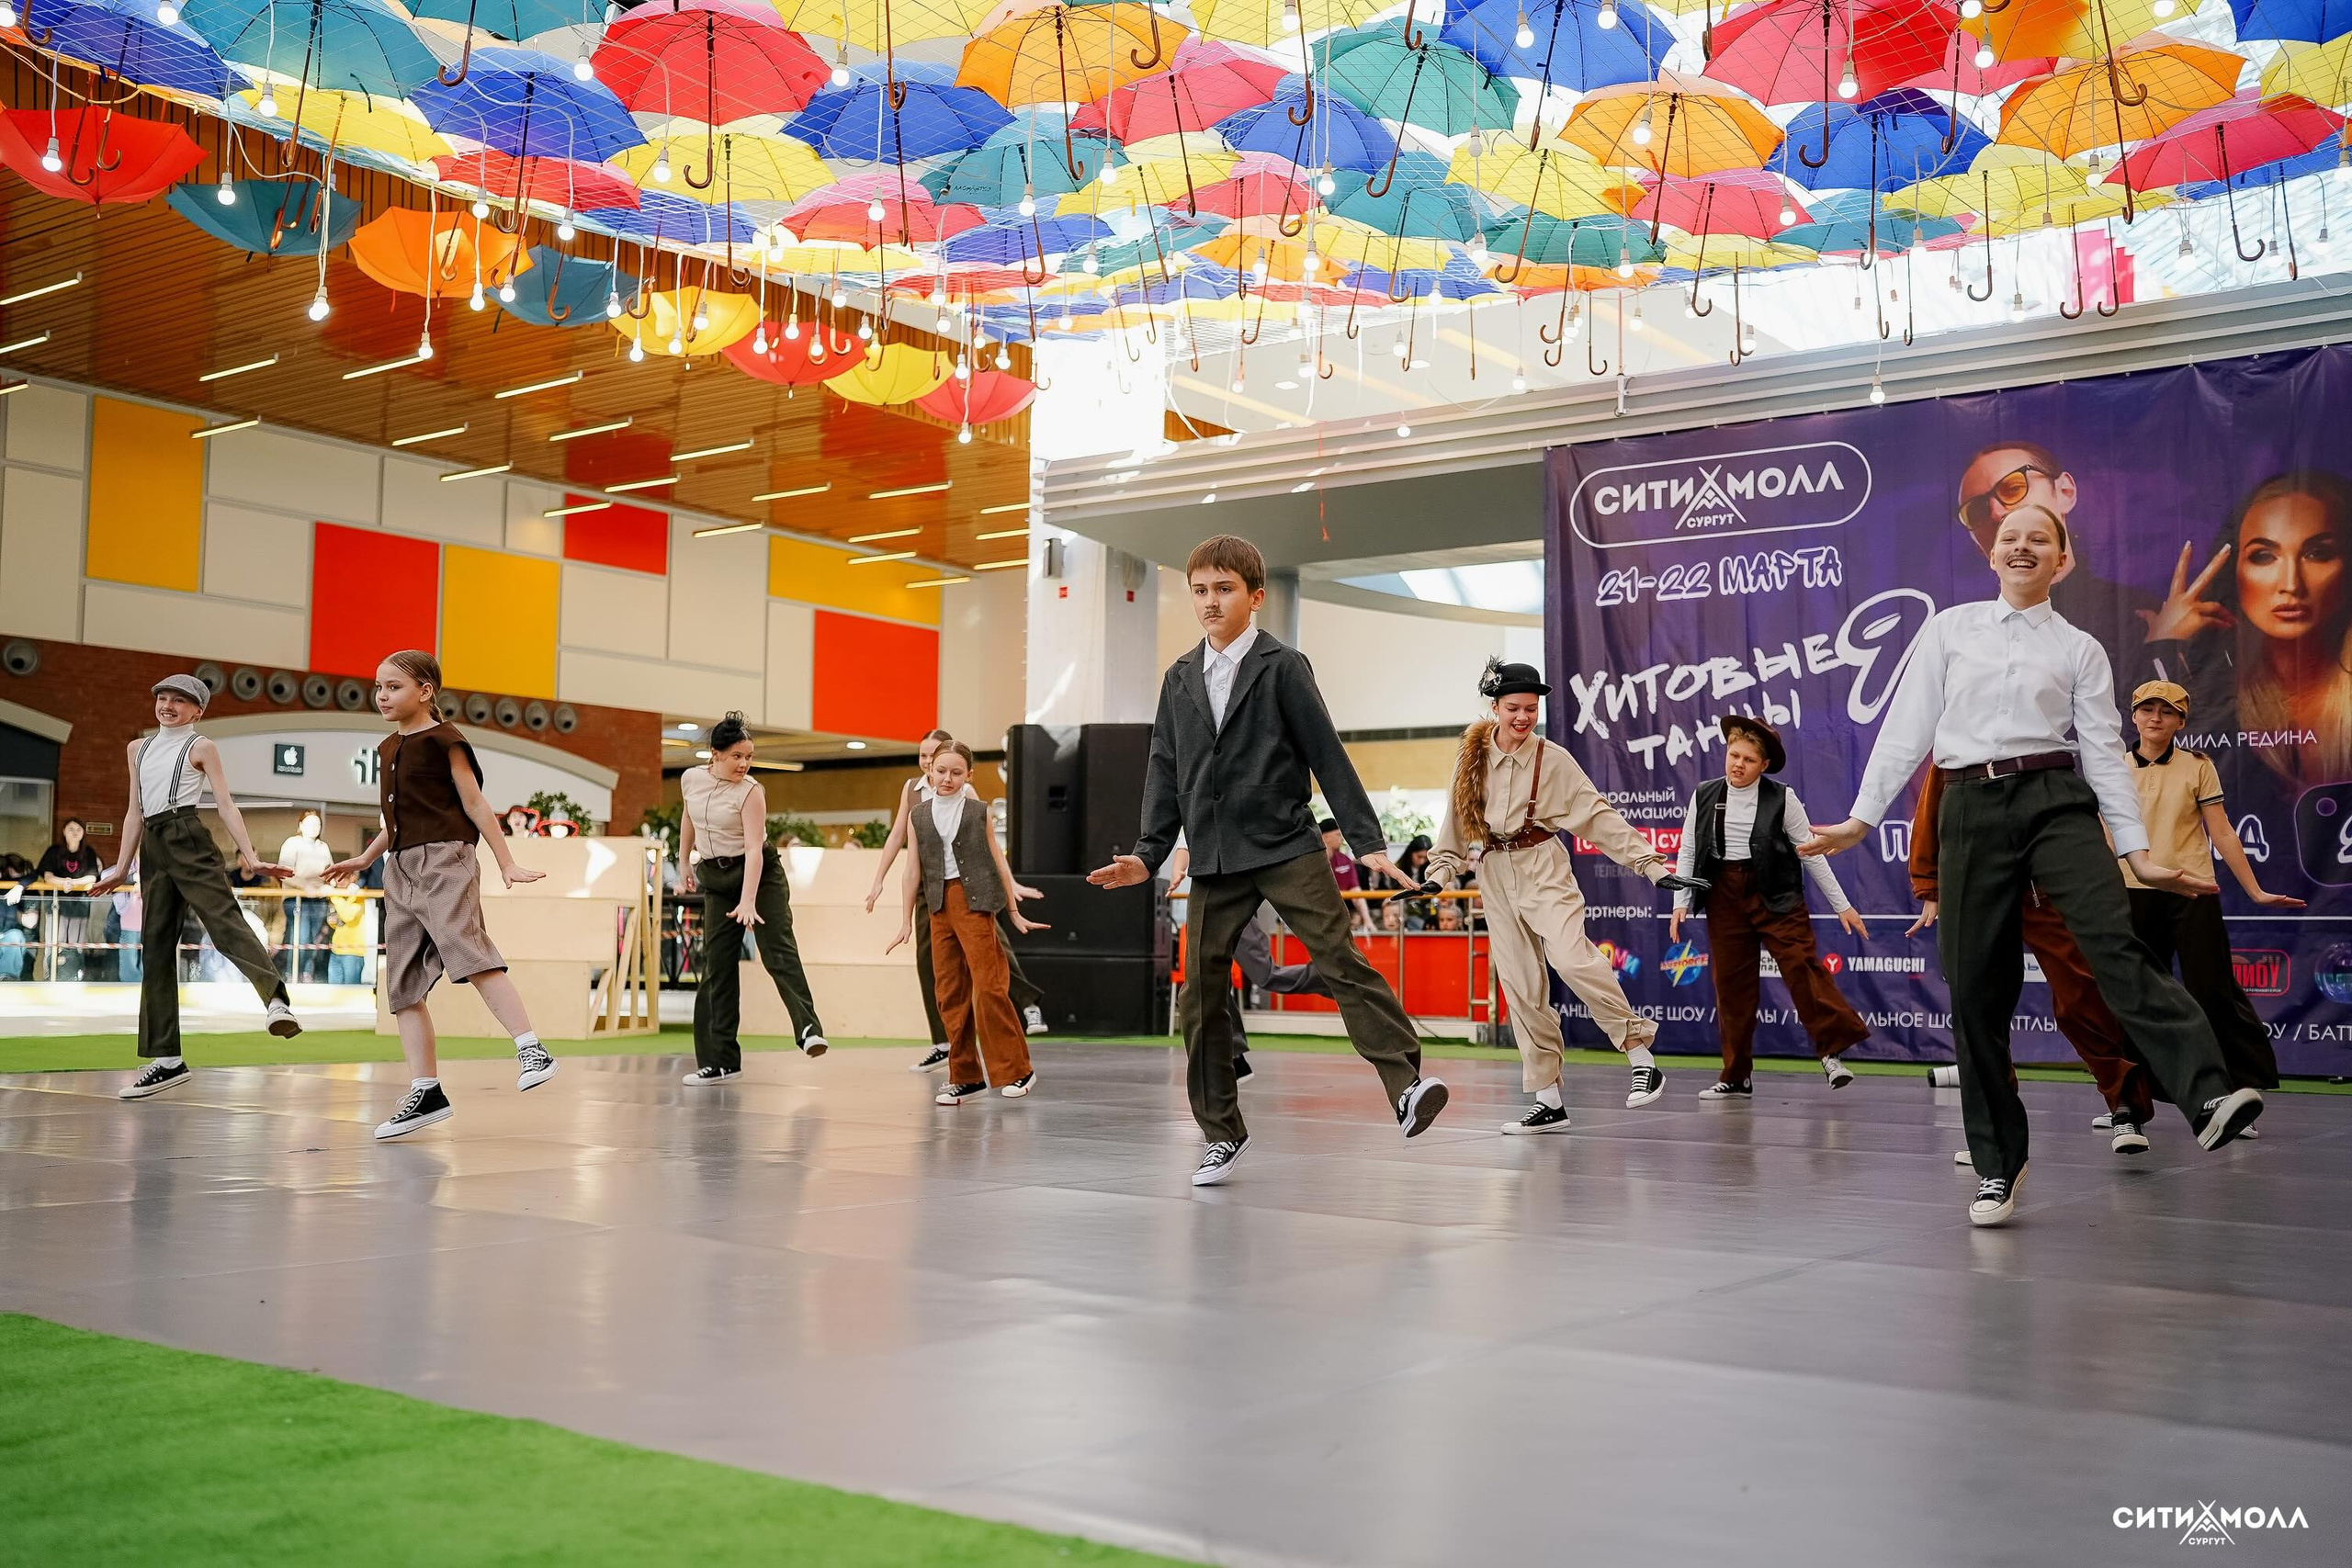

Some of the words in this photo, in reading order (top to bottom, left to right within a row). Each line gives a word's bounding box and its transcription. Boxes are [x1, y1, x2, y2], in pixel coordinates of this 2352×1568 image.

[1594, 477, 1693, 515] СИТИ
[1727, 461, 1844, 501] МОЛЛ
[1686, 513, 1735, 529] СУРГУТ
[1595, 562, 1712, 607] 21-22
[1719, 546, 1843, 596] МАРТА
[1569, 634, 1838, 739] ХИТОВЫЕ
[1627, 689, 1801, 770] ТАНЫ
[2237, 729, 2317, 748] РЕДИНА
[1601, 785, 1675, 804] ральный
[1584, 905, 1652, 920] артнеры:
[1848, 956, 1926, 973] YAMAGUCHI
[1667, 1006, 1705, 1021] ШОУ
[1710, 1007, 1717, 1023] /
[1781, 1010, 1789, 1025] /
[1928, 1013, 1952, 1029] ШО
[2010, 1016, 2058, 1032] ТТЛЫ
[2293, 1023, 2302, 1041] /
[2309, 1024, 2352, 1041] БАТТ
